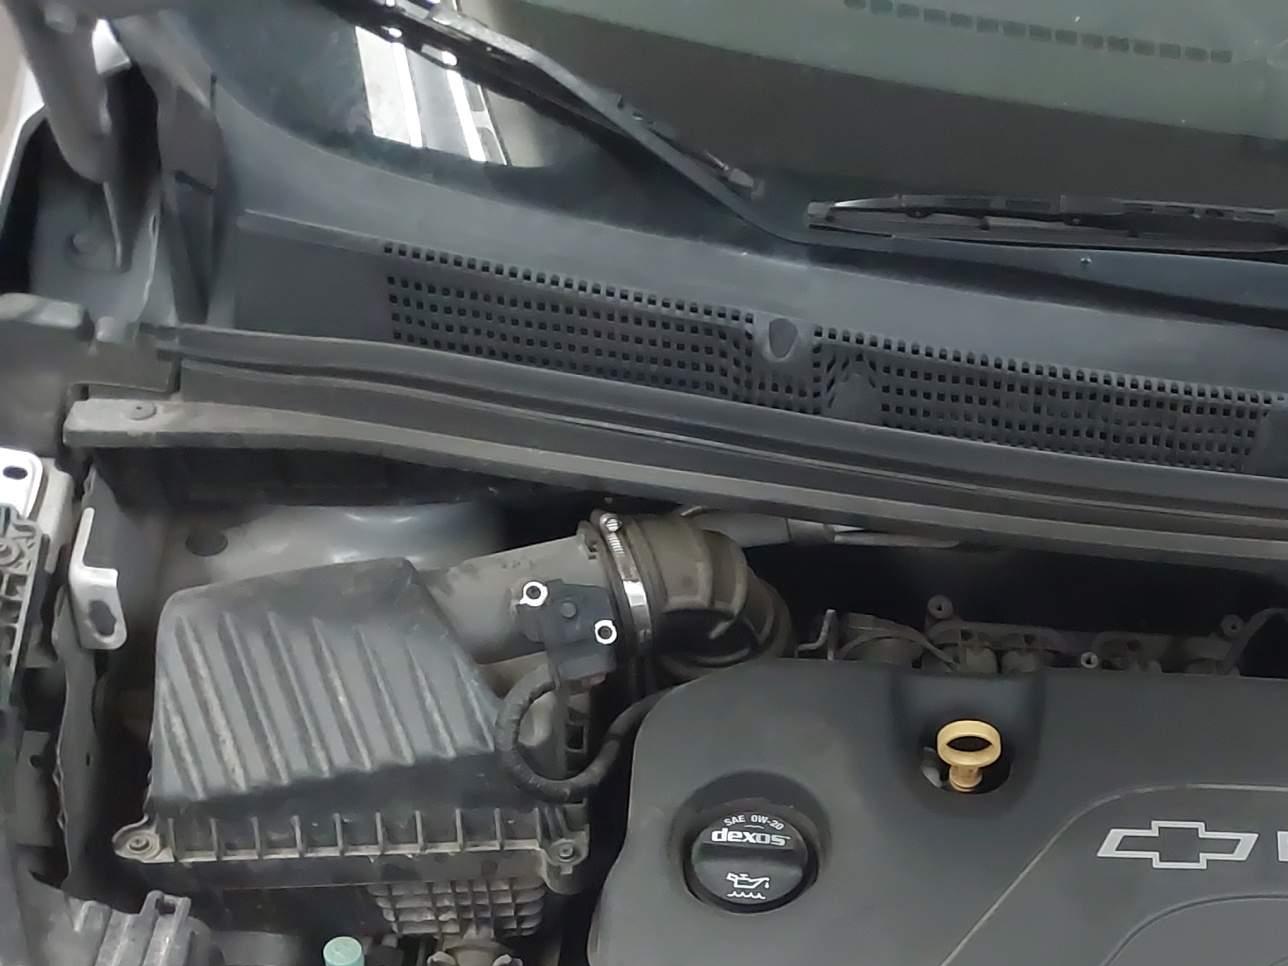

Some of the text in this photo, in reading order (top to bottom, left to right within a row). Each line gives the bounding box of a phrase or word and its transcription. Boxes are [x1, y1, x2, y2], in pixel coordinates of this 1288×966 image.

[724, 815, 785, 831] SAE 0W-20
[711, 828, 791, 846] dexos
